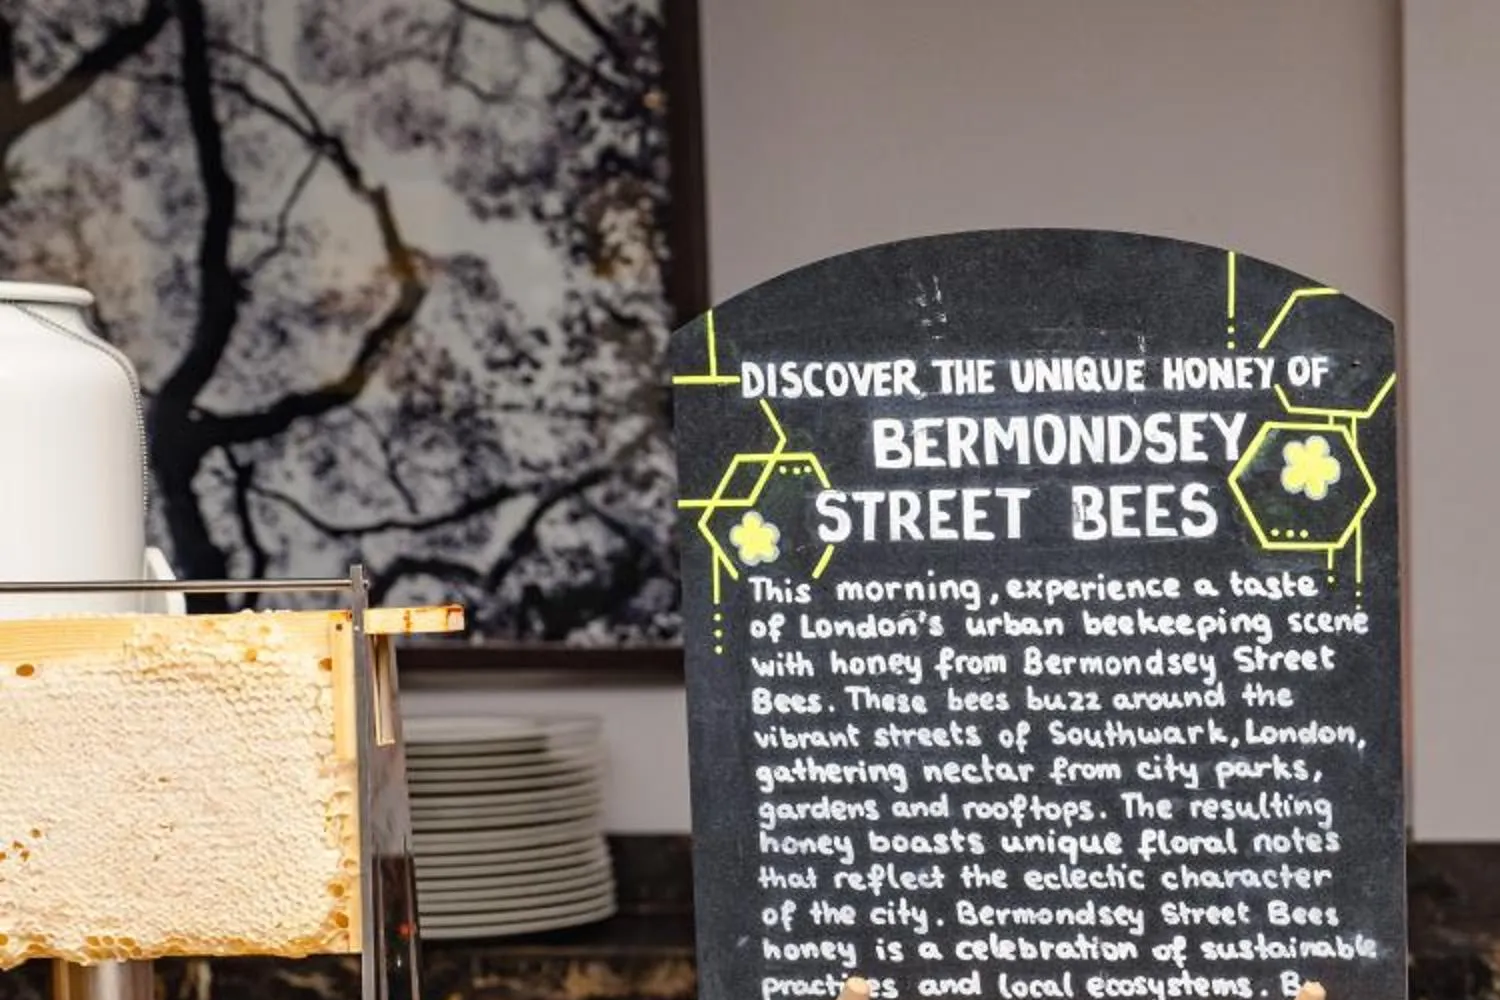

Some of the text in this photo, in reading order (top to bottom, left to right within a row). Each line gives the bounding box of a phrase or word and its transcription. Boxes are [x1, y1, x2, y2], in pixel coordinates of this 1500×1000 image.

[741, 353, 1330, 401] DISCOVER THE UNIQUE HONEY OF
[871, 411, 1248, 470] BERMONDSEY
[815, 481, 1219, 543] STREET BEES
[747, 575, 812, 605] This
[1005, 572, 1181, 606] experience
[1193, 577, 1221, 597] a
[1229, 569, 1319, 601] taste
[749, 607, 1369, 645] of London's urban beekeeping scene
[750, 644, 1336, 687] with honey from Bermondsey Street
[843, 685, 929, 715] These
[947, 687, 1011, 713] bees
[1026, 684, 1103, 712] buzz
[1112, 680, 1227, 712] around
[1241, 681, 1295, 708] the
[753, 717, 1367, 754] vibrant streets of Southwark, London,
[755, 752, 1323, 794] gathering nectar from city parks,
[758, 791, 1333, 831] gardens and rooftops. The resulting
[759, 826, 1341, 866] honey boasts unique floral notes
[757, 862, 1333, 897] that reflect the eclectic character
[761, 899, 797, 933] of
[808, 899, 857, 926] the
[955, 899, 1145, 937] Bermondsey
[1160, 900, 1251, 926] Street
[1267, 899, 1340, 927] Bees
[761, 931, 1378, 969] honey is a celebration of sustainable
[917, 969, 983, 997] and
[997, 970, 1075, 1000] local
